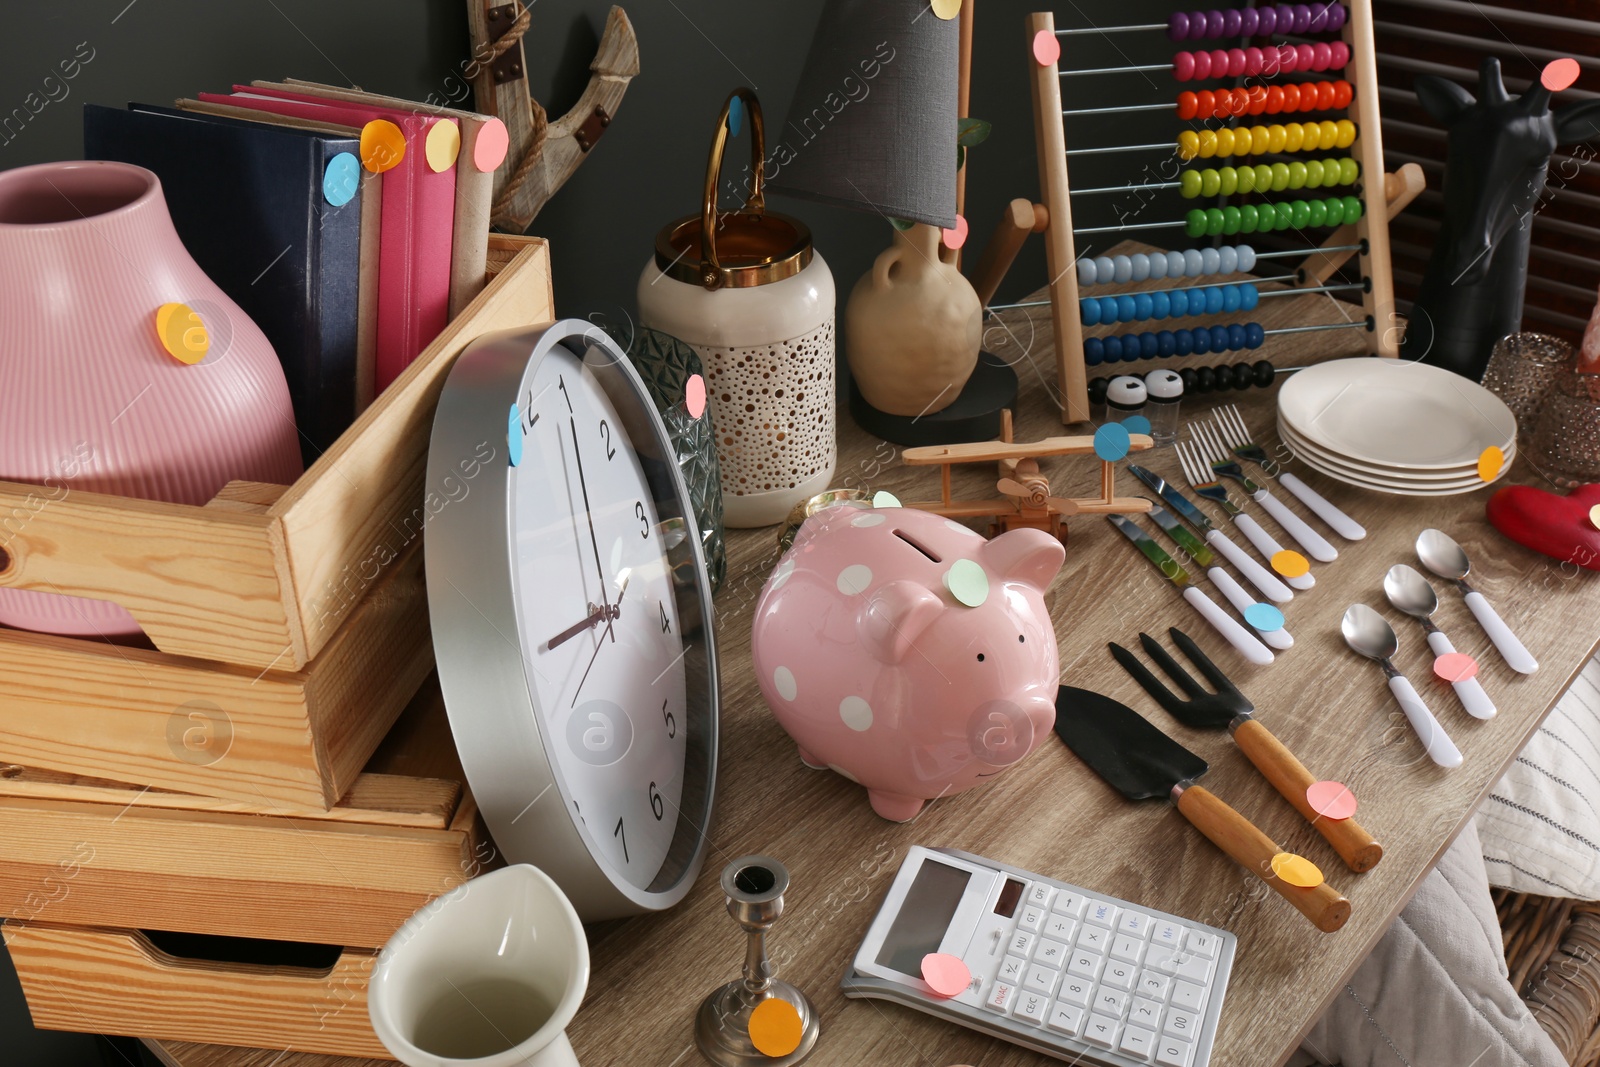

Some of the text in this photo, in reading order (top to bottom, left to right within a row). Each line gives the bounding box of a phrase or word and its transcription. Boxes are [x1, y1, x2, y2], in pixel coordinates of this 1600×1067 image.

[559, 374, 573, 414] 1
[600, 420, 616, 462] 2
[636, 501, 649, 539] 3
[659, 600, 671, 634] 4
[662, 698, 676, 739] 5
[649, 781, 663, 821] 6
[614, 816, 629, 864] 7
[1035, 888, 1045, 900] OFF
[1027, 913, 1036, 923] GT
[1096, 906, 1107, 920] MRC
[1163, 926, 1174, 939] M+
[1016, 937, 1027, 949] MU
[1080, 958, 1091, 967] 9
[1114, 969, 1125, 977] 6
[1070, 985, 1082, 993] 8
[1148, 980, 1160, 988] 3
[995, 986, 1008, 1005] ON/AC
[1104, 996, 1116, 1005] 5
[1026, 997, 1038, 1014] CE/C
[1059, 1012, 1071, 1020] 7
[1140, 1008, 1152, 1016] 2
[1096, 1024, 1107, 1033] 4
